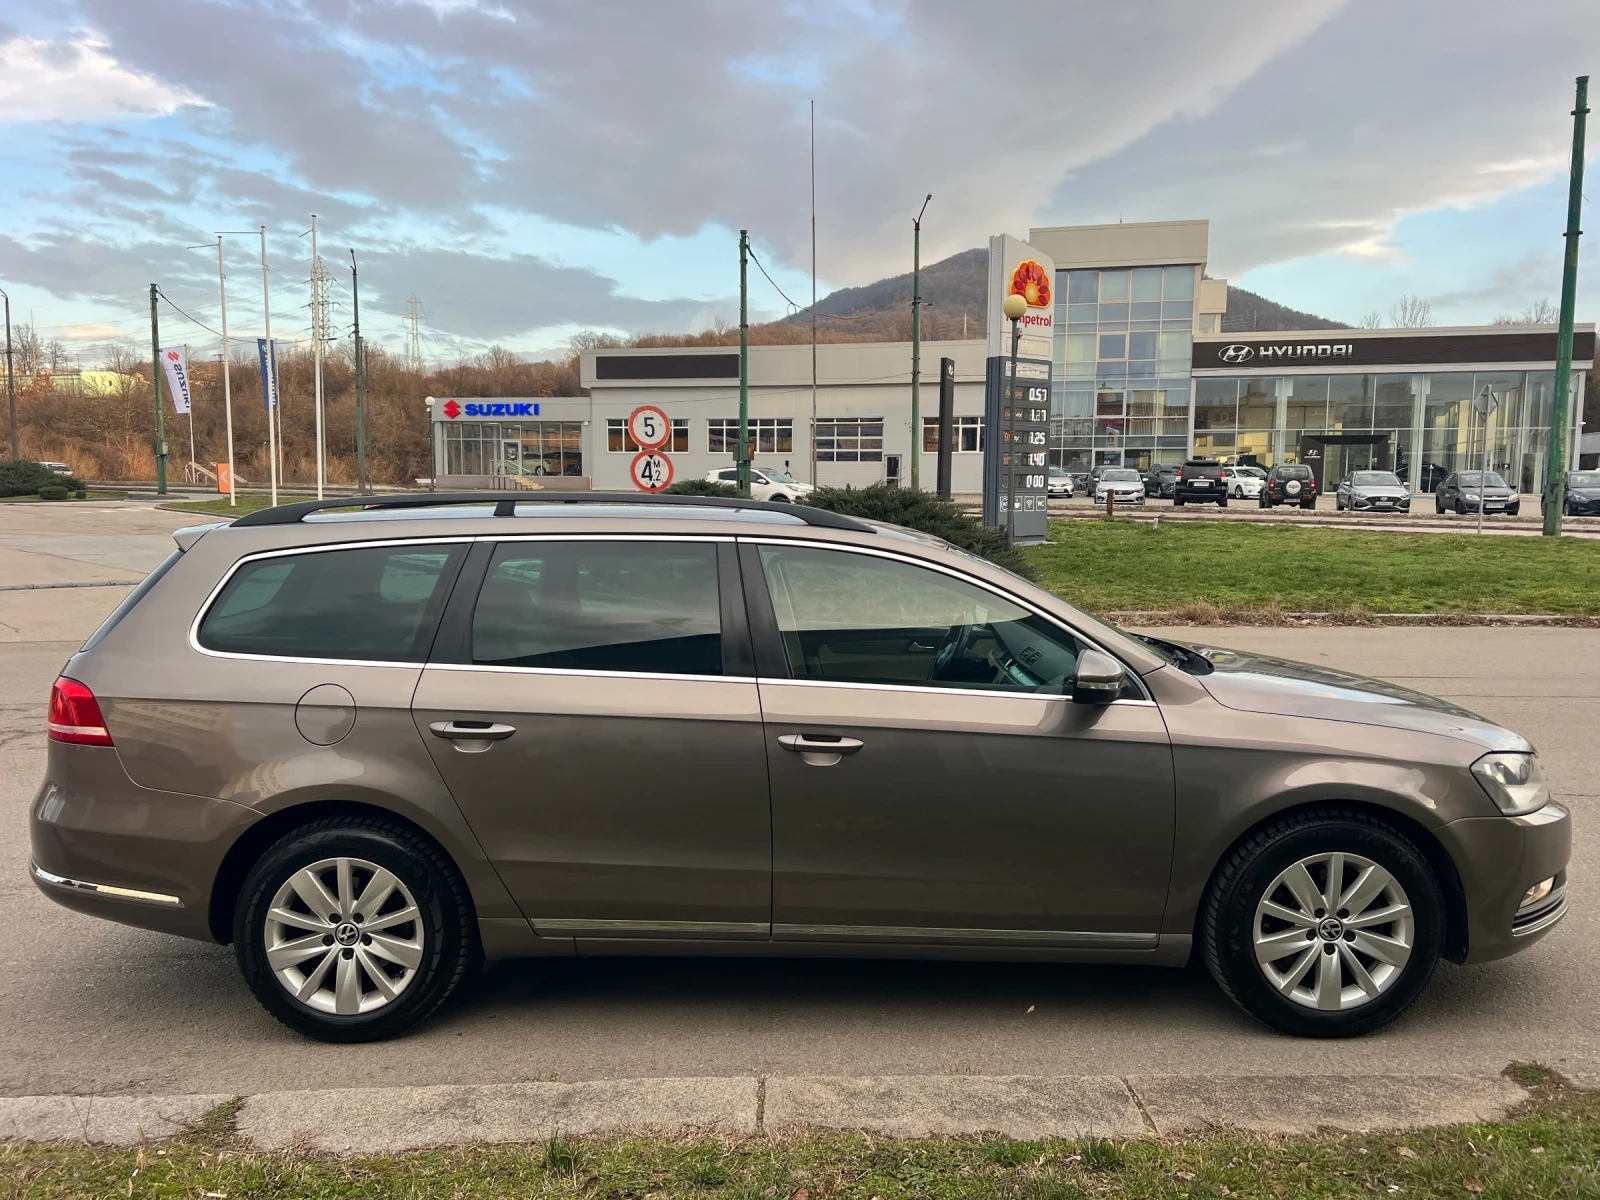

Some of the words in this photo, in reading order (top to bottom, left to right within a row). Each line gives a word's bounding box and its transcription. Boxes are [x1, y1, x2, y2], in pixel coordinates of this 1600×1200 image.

[1259, 345, 1353, 360] HYUNDAI
[1029, 387, 1047, 401] 0.57
[464, 403, 540, 416] SUZUKI
[644, 417, 655, 438] 5
[1030, 431, 1046, 445] 1.25
[1029, 452, 1045, 466] 1.40
